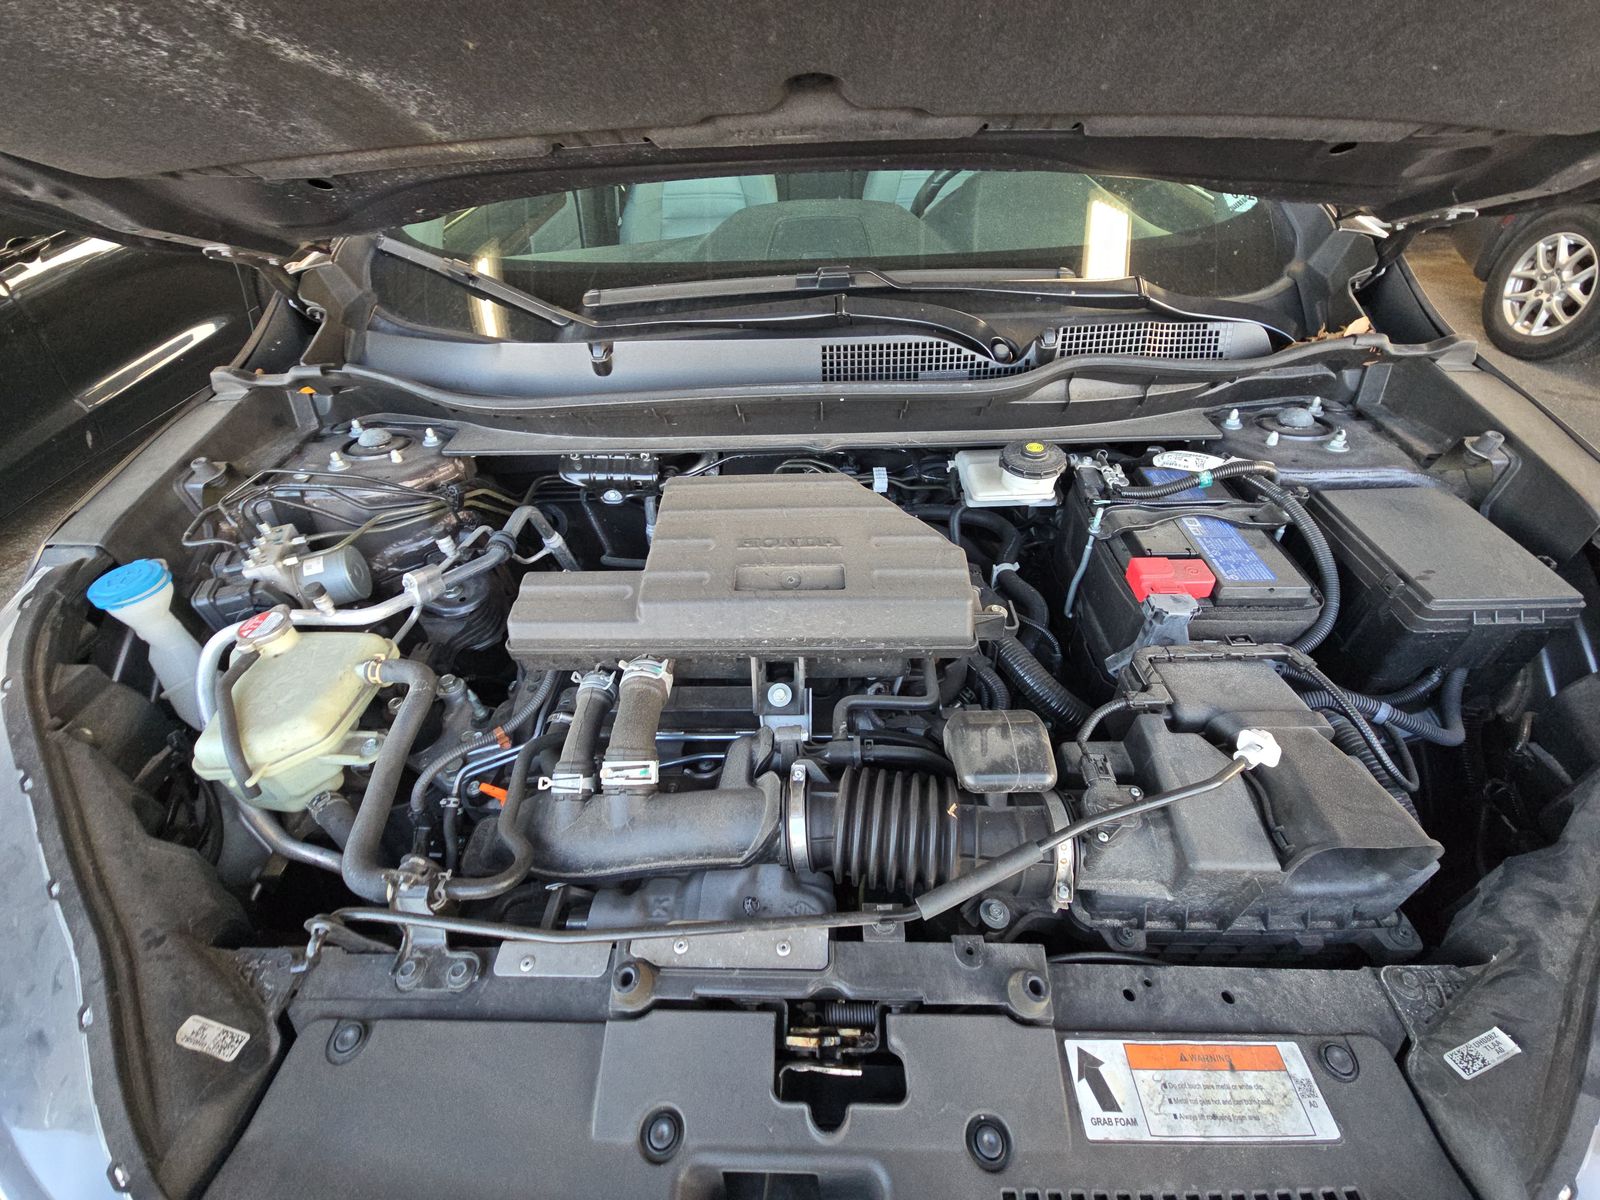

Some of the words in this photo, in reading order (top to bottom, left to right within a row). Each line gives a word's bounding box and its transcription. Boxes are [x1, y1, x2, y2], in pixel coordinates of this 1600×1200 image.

[1187, 1054, 1231, 1063] WARNING
[1090, 1117, 1114, 1126] GRAB
[1114, 1117, 1139, 1126] FOAM
